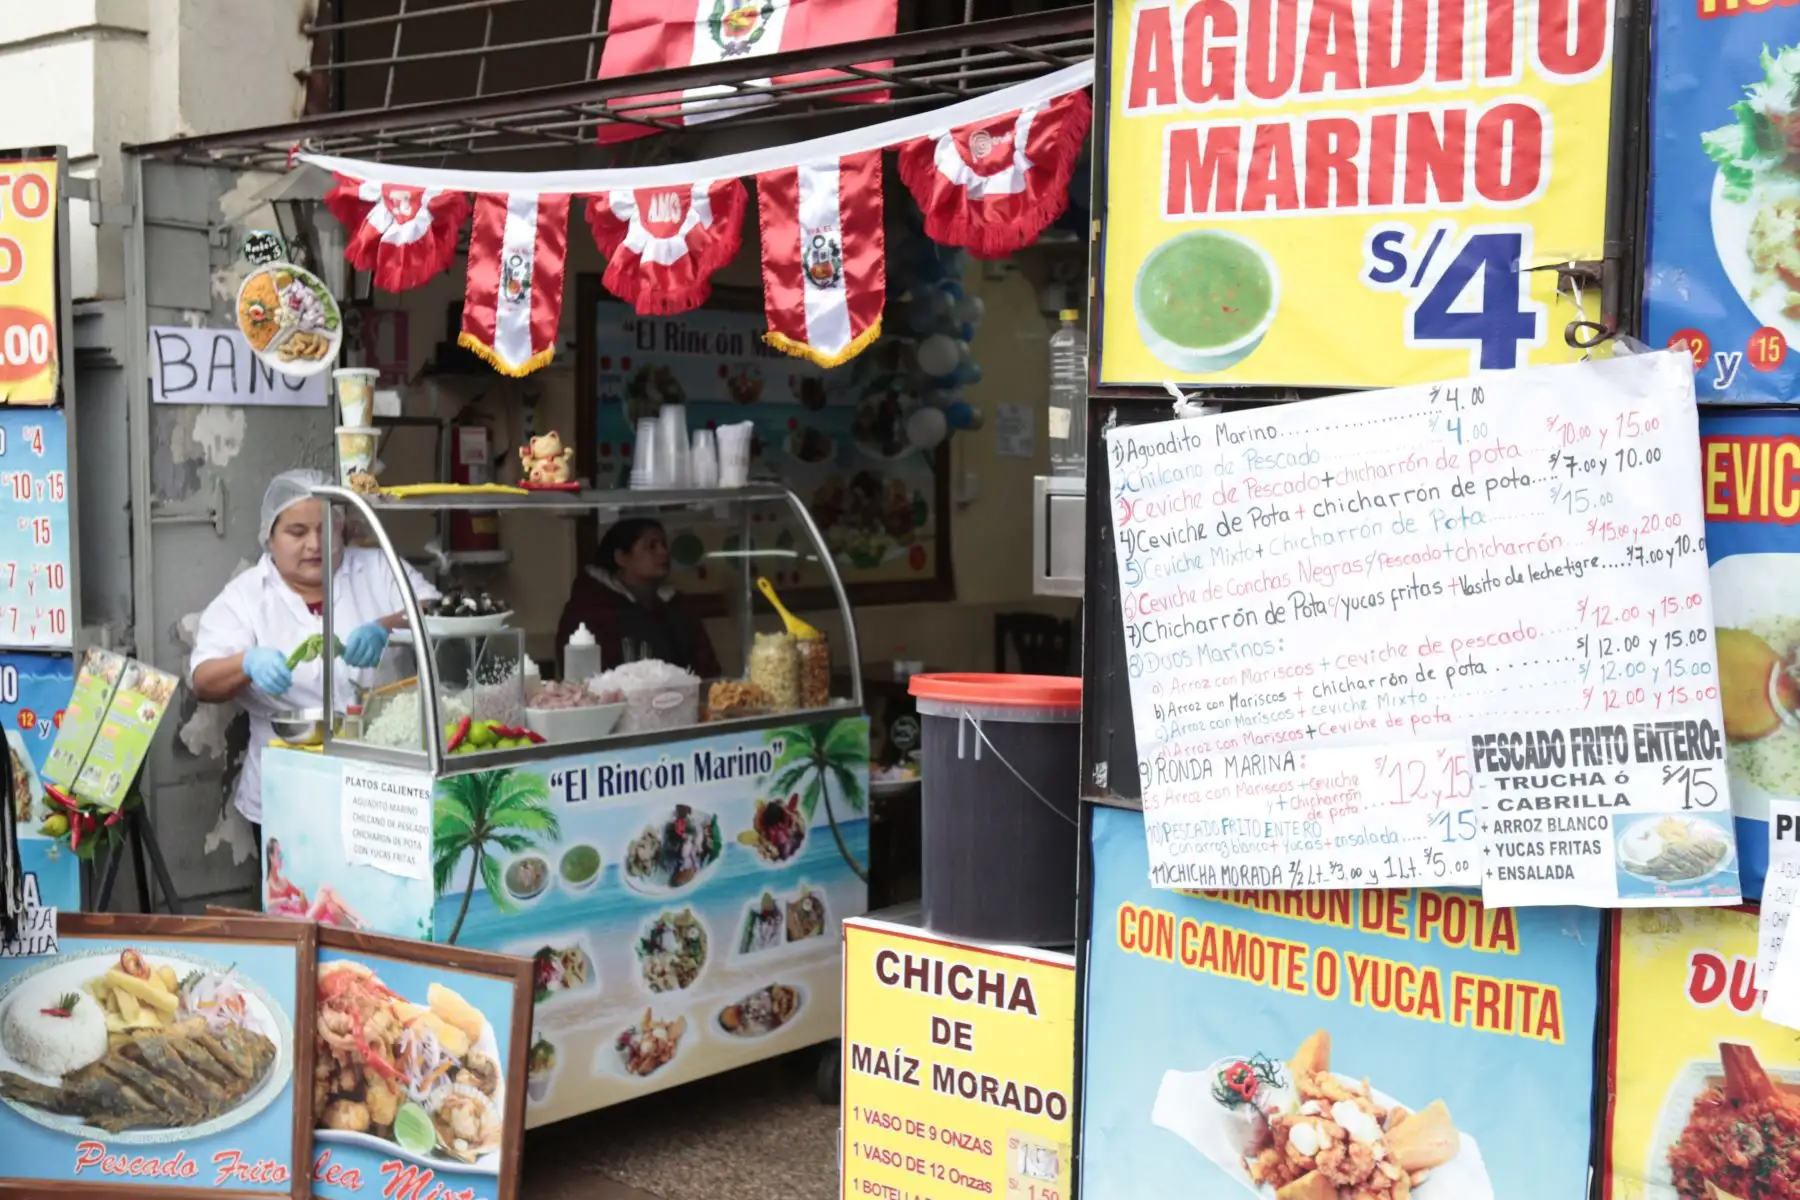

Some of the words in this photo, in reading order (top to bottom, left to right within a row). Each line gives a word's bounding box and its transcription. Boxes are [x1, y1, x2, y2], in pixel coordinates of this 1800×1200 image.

[1127, 0, 1608, 109] AGUADITO
[1166, 103, 1543, 215] MARINO
[648, 192, 681, 222] AMO
[665, 322, 743, 356] Rincón
[1715, 352, 1741, 389] y
[1216, 422, 1277, 446] Marino
[1212, 477, 1240, 505] de
[1435, 452, 1458, 473] de
[1468, 437, 1522, 475] pota
[1600, 428, 1608, 449] y
[1616, 411, 1659, 438] 15.00
[1214, 453, 1234, 477] de
[1242, 441, 1320, 472] Pescado
[48, 473, 64, 499] 15
[1216, 511, 1243, 537] de
[1247, 503, 1290, 529] Pota
[1314, 483, 1440, 517] chicharrón
[1451, 476, 1476, 498] de
[1486, 468, 1530, 500] pota
[1600, 458, 1607, 475] y
[1615, 448, 1661, 472] 10.00
[1391, 510, 1418, 535] de
[1429, 505, 1486, 532] Pota
[1202, 579, 1223, 602] de
[1227, 570, 1290, 597] Conchas
[1641, 513, 1682, 534] 20.00
[1264, 600, 1285, 625] de
[1288, 590, 1327, 620] Pota
[1391, 572, 1442, 611] fritas
[1505, 565, 1524, 585] de
[1214, 675, 1237, 688] con
[1241, 662, 1314, 686] Mariscos
[1418, 634, 1445, 657] de
[1451, 619, 1537, 661] pescado
[1591, 605, 1640, 628] 12.00
[1647, 607, 1656, 627] y
[1660, 593, 1702, 617] 15.00
[1206, 700, 1224, 711] con
[1229, 692, 1287, 712] Mariscos
[1312, 673, 1408, 698] chicharrón
[1416, 662, 1436, 682] de
[1446, 654, 1487, 690] pota
[1599, 635, 1640, 659] 12.00
[1649, 638, 1657, 657] y
[1664, 628, 1707, 650] 15.00
[1210, 718, 1231, 730] con
[1235, 709, 1294, 728] Mariscos
[1377, 687, 1427, 710] Mixto
[1600, 661, 1646, 684] 12.00
[1652, 666, 1659, 684] y
[1665, 658, 1711, 678] 15.00
[1216, 739, 1238, 750] con
[1242, 729, 1304, 745] Mariscos
[1386, 712, 1403, 727] de
[1411, 705, 1452, 736] pota
[1654, 691, 1661, 709] y
[1668, 685, 1717, 705] 15.00
[1471, 728, 1566, 773] PESCADO
[1570, 724, 1628, 767] FRITO
[1633, 718, 1723, 763] ENTERO:
[345, 777, 378, 790] PLATOS
[381, 782, 430, 800] CALIENTES
[599, 758, 685, 797] Rincón
[1206, 787, 1231, 800] con
[1494, 772, 1607, 790] TRUCHA
[1614, 770, 1630, 785] ó
[1307, 807, 1323, 821] de
[1330, 805, 1359, 824] pota
[1432, 790, 1441, 809] y
[1497, 792, 1631, 812] CABRILLA
[1493, 818, 1542, 834] ARROZ
[1547, 815, 1608, 833] BLANCO
[1496, 842, 1544, 858] YUCAS
[1550, 840, 1601, 856] FRITAS
[1221, 864, 1282, 886] MORADA
[1498, 864, 1575, 881] ENSALADA
[1418, 890, 1517, 951] POTA
[875, 949, 1037, 1016] CHICHA
[1120, 905, 1173, 960] CON
[1179, 920, 1308, 992] CAMOTE
[1315, 951, 1338, 997] O
[1348, 958, 1441, 1019] YUCA
[1453, 976, 1562, 1040] FRITA
[932, 1016, 973, 1051] DE
[851, 1043, 920, 1086] MAÍZ
[933, 1064, 1067, 1121] MORADO
[853, 1106, 860, 1121] 1
[863, 1108, 902, 1132] VASO
[905, 1119, 926, 1138] DE
[929, 1126, 937, 1140] 9
[941, 1129, 993, 1156] ONZAS
[75, 1142, 198, 1178] Pescado
[213, 1151, 289, 1185] Frito
[853, 1142, 860, 1156] 1
[863, 1143, 902, 1168] VASO
[905, 1156, 926, 1175] DE
[930, 1162, 945, 1180] 12
[949, 1168, 993, 1194] Onzas
[853, 1178, 859, 1191] 1
